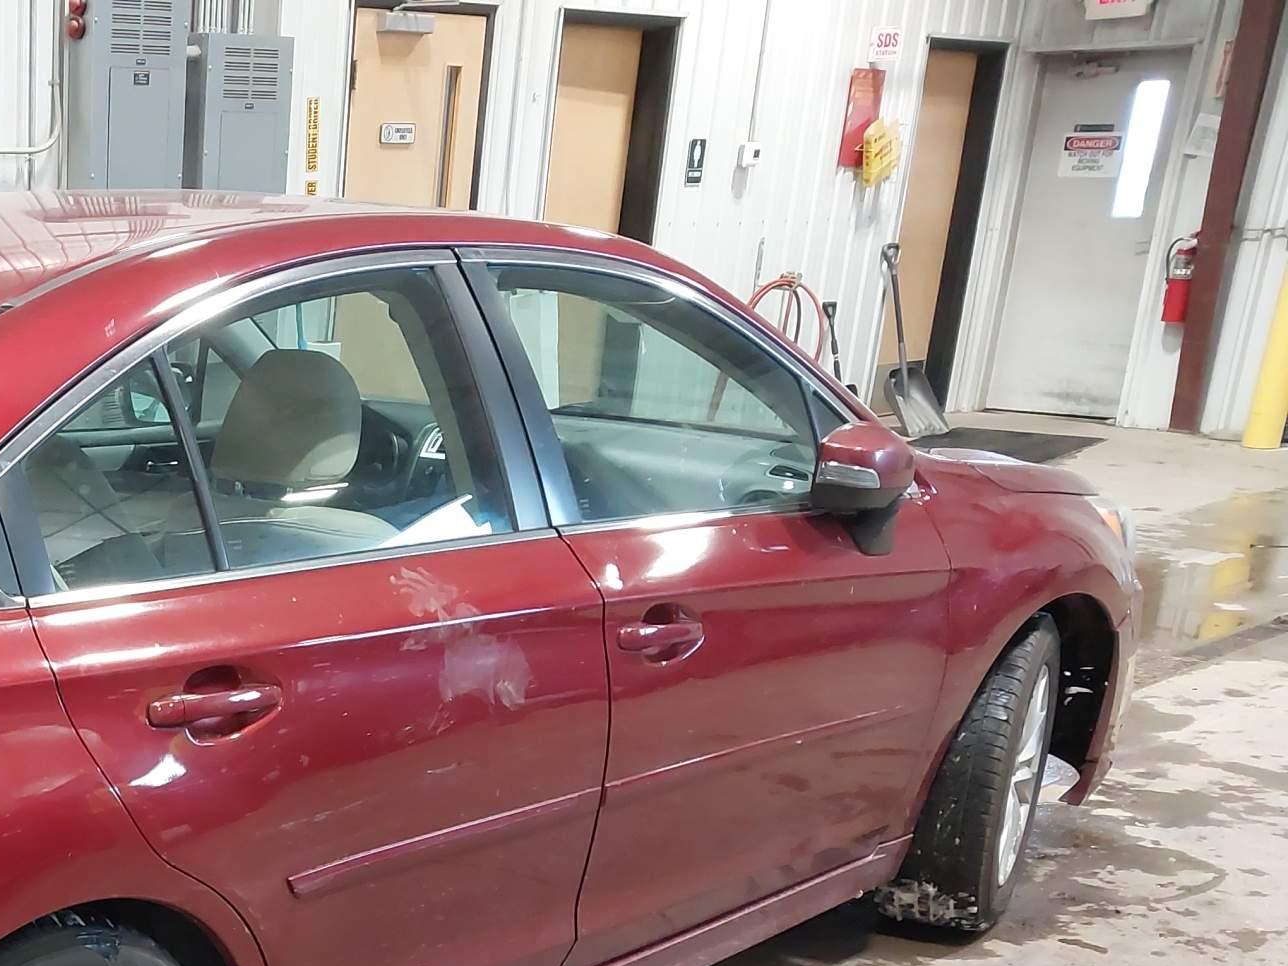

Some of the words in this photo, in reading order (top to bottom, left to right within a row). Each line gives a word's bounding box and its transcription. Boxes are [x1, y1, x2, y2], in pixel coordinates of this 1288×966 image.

[876, 32, 899, 48] SDS
[1072, 139, 1113, 148] DANGER
[307, 134, 318, 170] STUDENT
